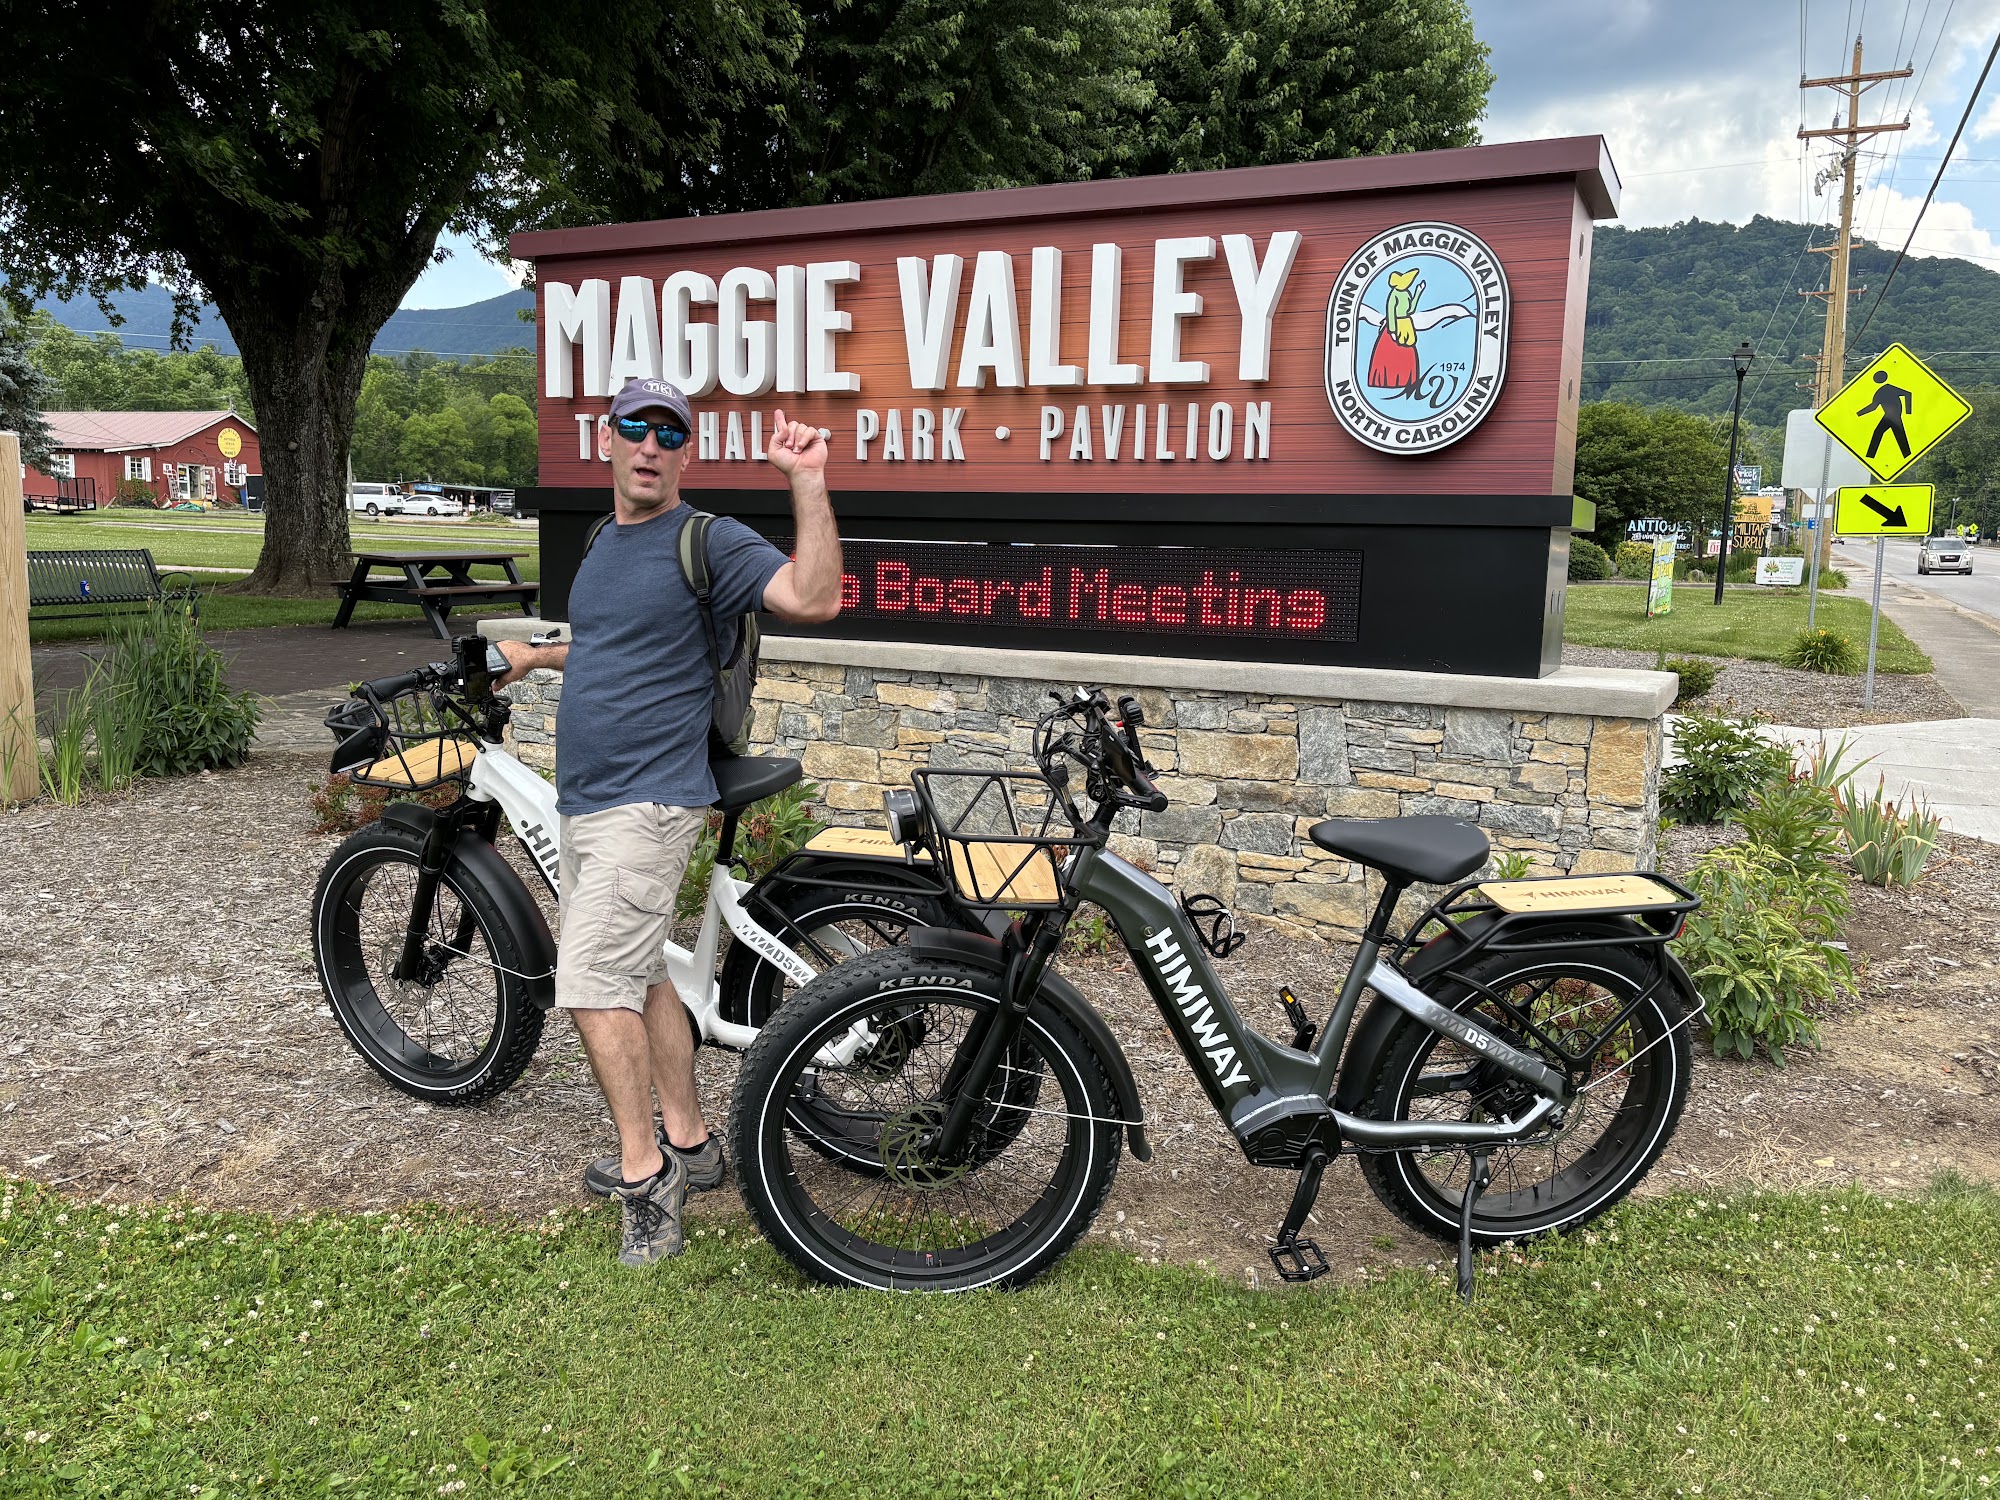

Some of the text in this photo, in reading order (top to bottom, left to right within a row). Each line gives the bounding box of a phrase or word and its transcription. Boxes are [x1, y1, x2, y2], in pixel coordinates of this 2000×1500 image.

[1336, 231, 1500, 347] TOWN OF MAGGIE VALLEY
[545, 231, 1303, 399] MAGGIE VALLEY
[1440, 362, 1466, 372] 1974
[1335, 374, 1494, 444] NORTH CAROLINA
[699, 411, 779, 460] HAL
[857, 407, 965, 461] PARK
[1040, 401, 1271, 461] PAVILION
[1627, 519, 1692, 533] ANTIQUES
[877, 561, 1050, 617] Board
[1069, 567, 1325, 628] Meeting
[844, 893, 919, 917] KENDA
[1540, 887, 1627, 899] HIMIWAY
[772, 948, 796, 970] D5
[878, 975, 974, 991] KENDA
[1145, 926, 1251, 1089] HIMIWAY
[1463, 1026, 1490, 1050] D5
[449, 1068, 493, 1097] KENDA
